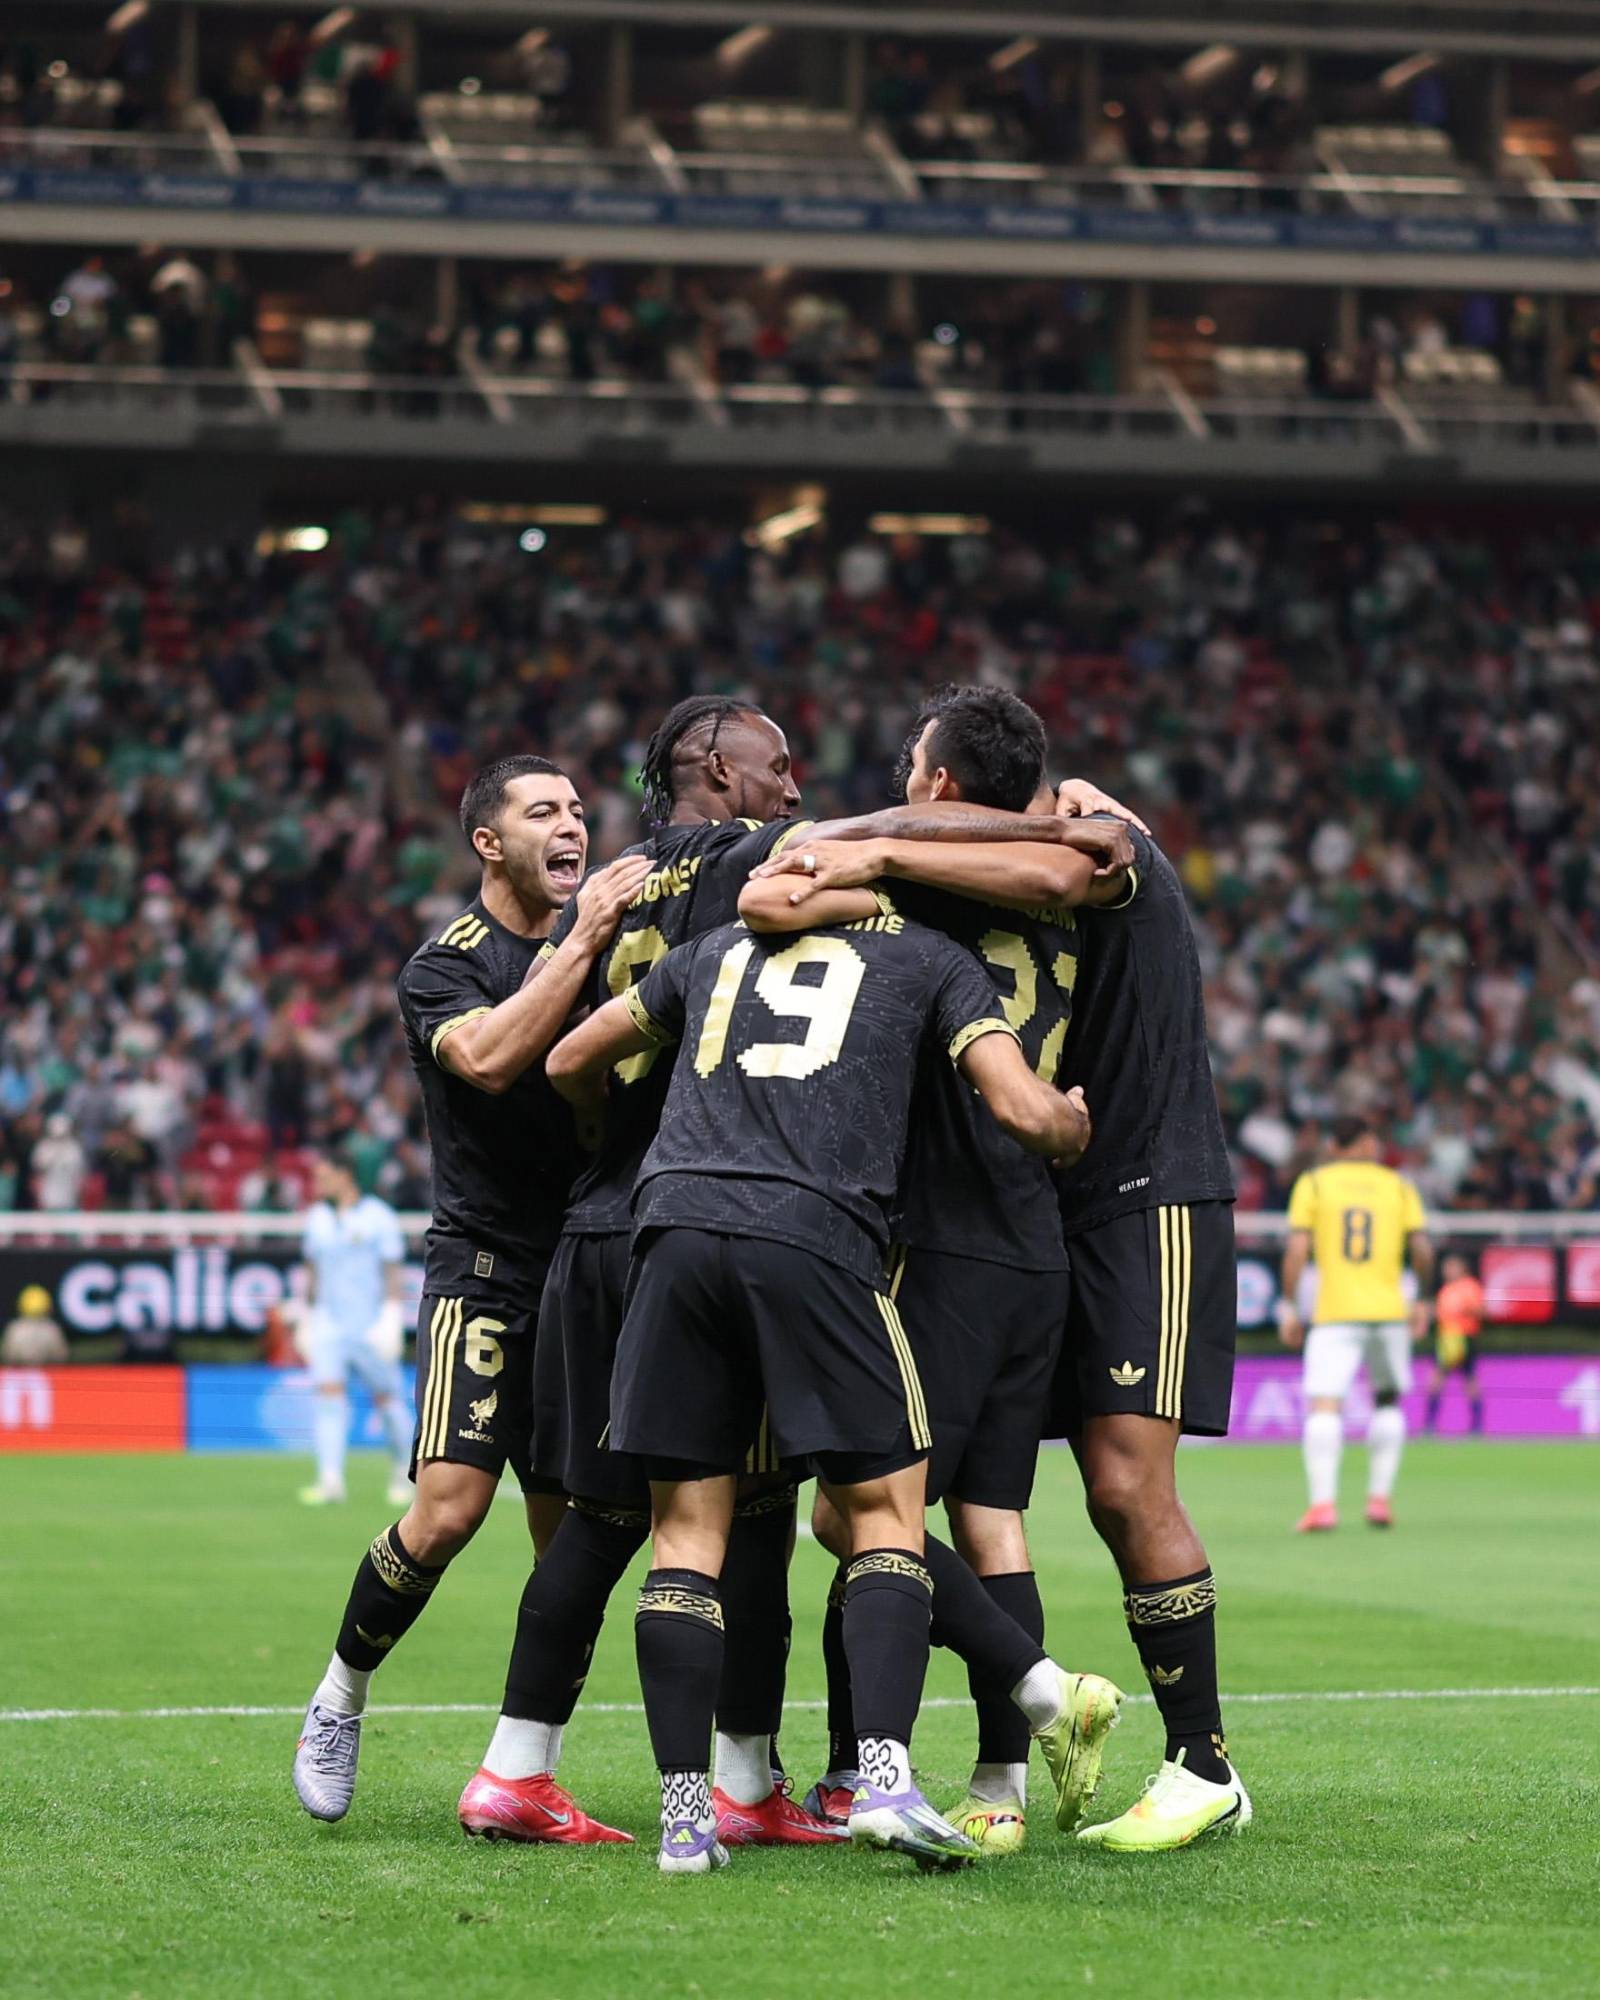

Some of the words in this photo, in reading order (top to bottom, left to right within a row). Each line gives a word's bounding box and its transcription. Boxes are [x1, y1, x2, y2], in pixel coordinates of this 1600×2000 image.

[693, 935, 867, 1081] 19
[1343, 1207, 1373, 1263] 8
[59, 1248, 425, 1332] calie
[465, 1316, 508, 1377] 6
[458, 1428, 495, 1444] MÉXICO
